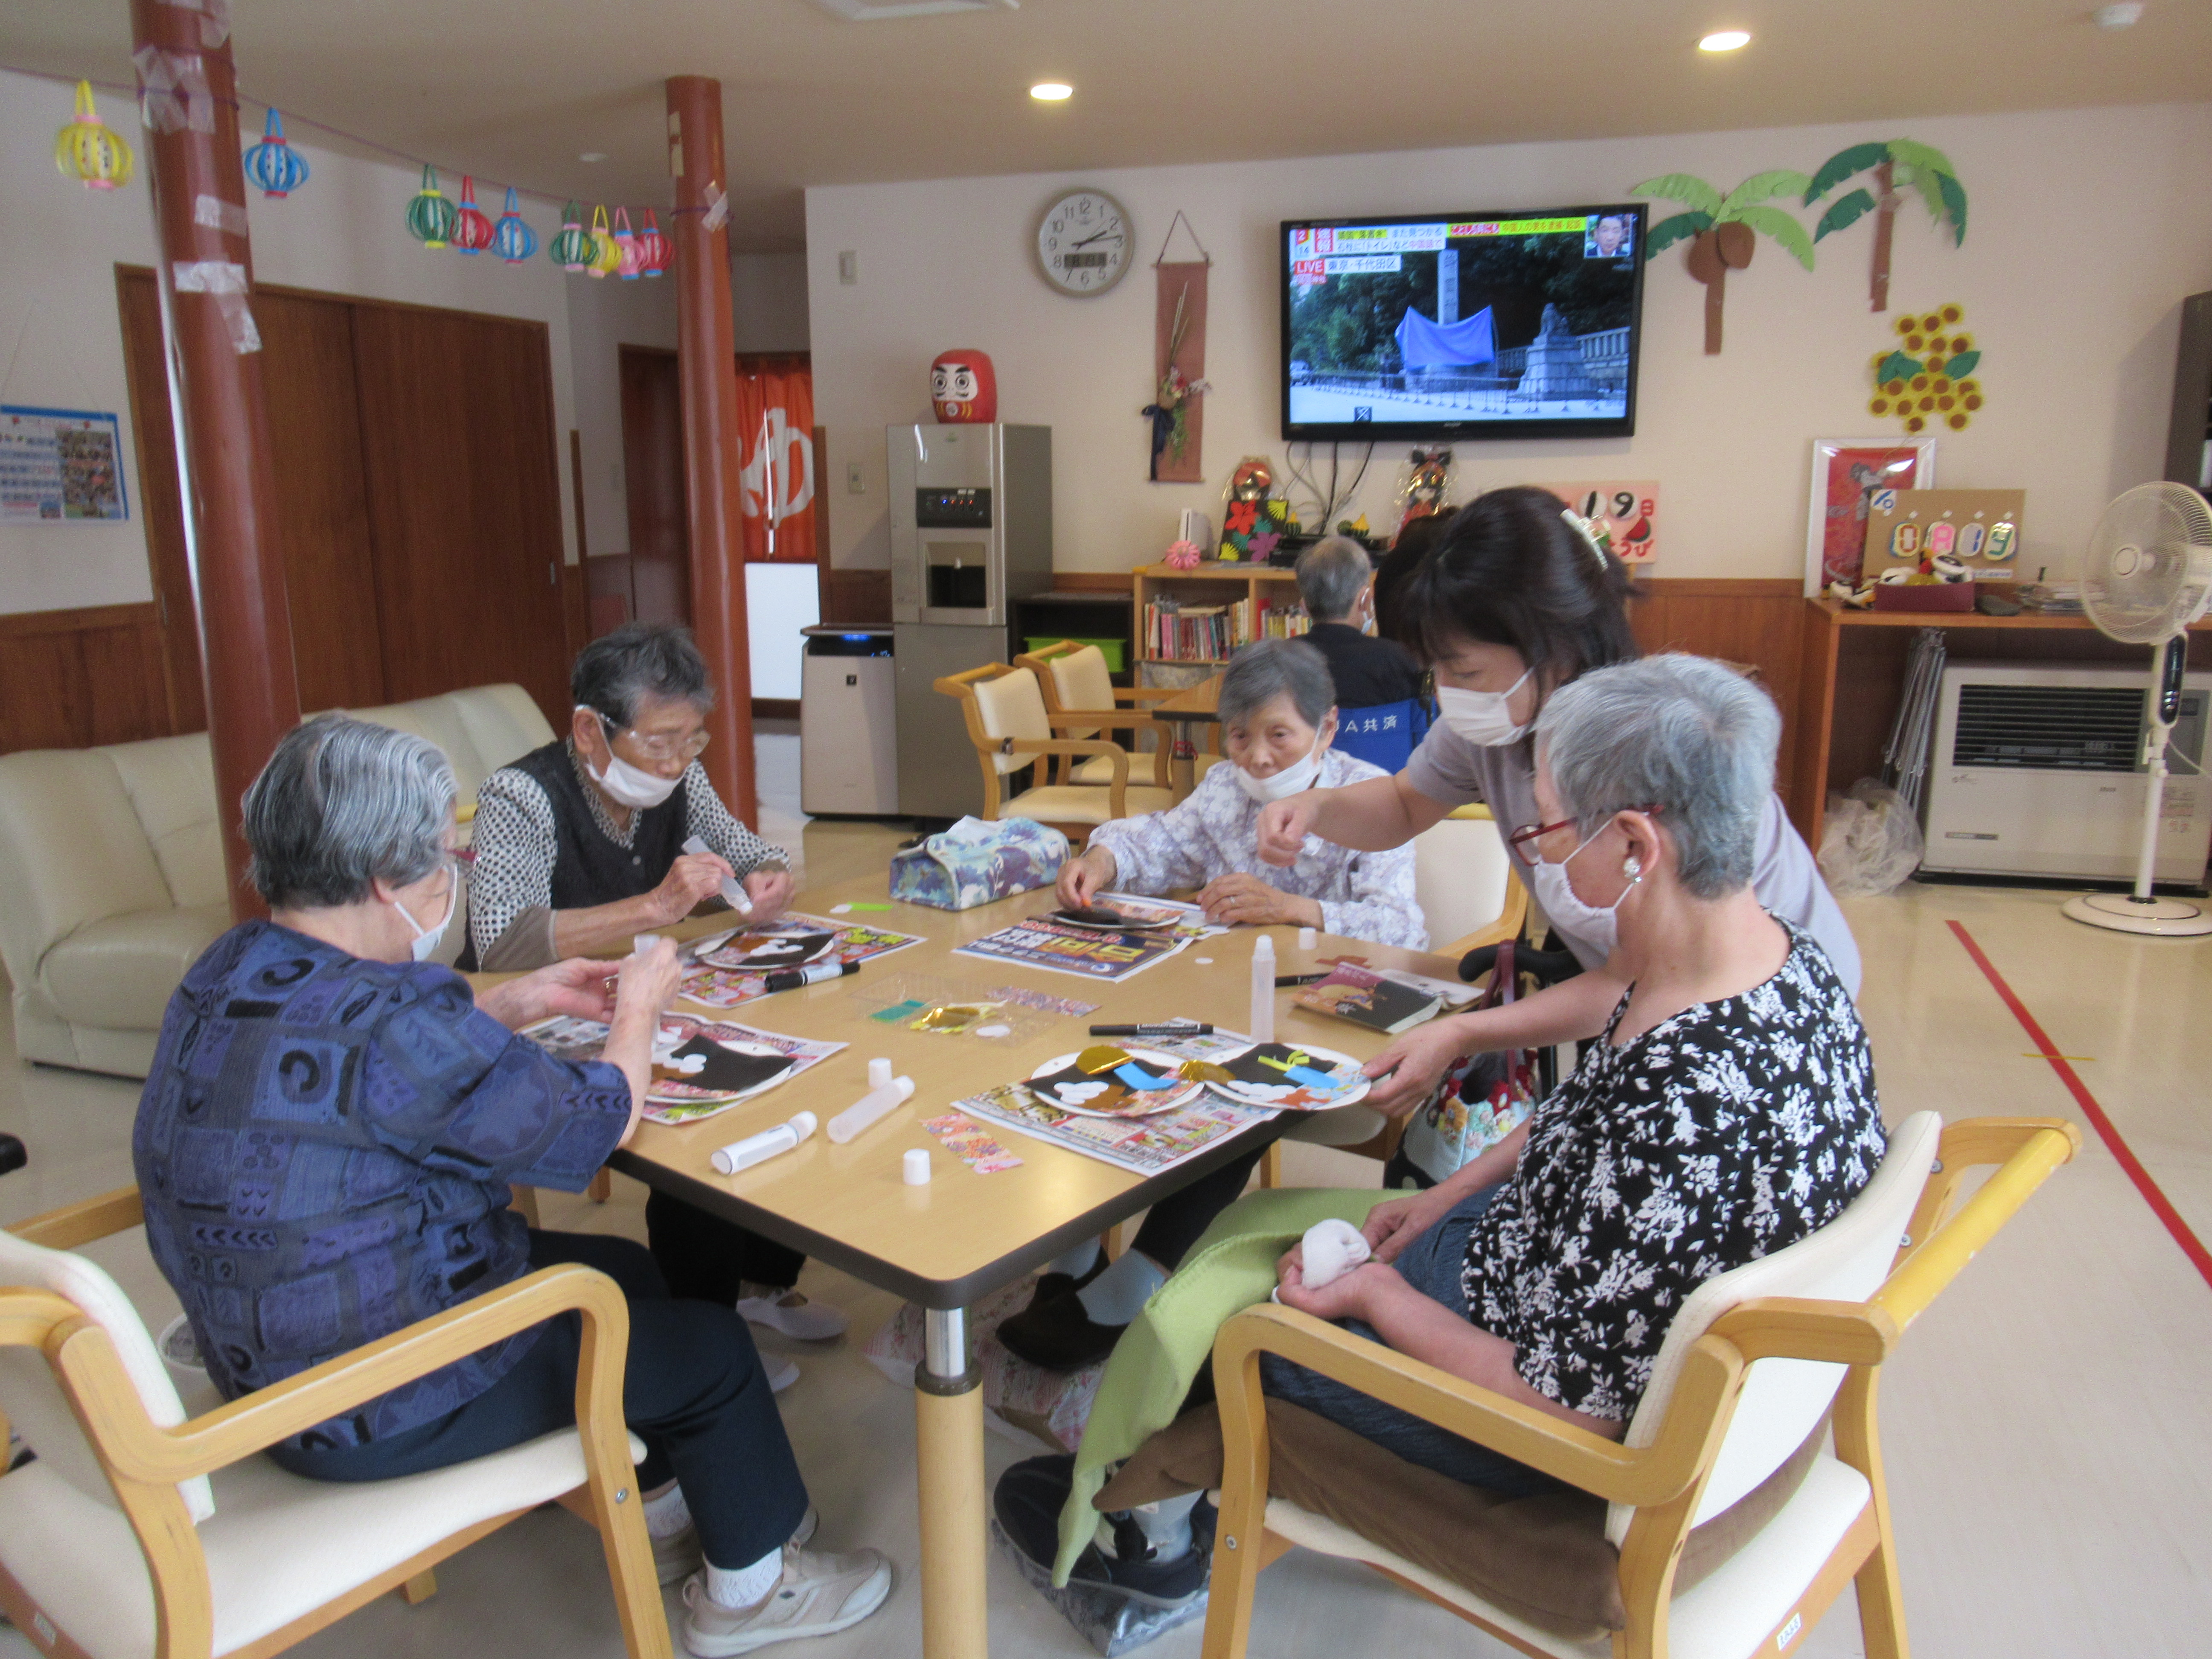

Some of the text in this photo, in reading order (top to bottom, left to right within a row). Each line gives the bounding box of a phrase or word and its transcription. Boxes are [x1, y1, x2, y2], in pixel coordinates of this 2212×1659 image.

[1064, 206, 1074, 219] 11
[1078, 198, 1091, 215] 12
[1052, 219, 1064, 234] 10
[1109, 215, 1120, 230] 2
[1114, 236, 1123, 248] 3
[1298, 230, 1306, 241] 2
[1048, 237, 1057, 251] 9
[1053, 255, 1062, 268] 8
[1109, 253, 1118, 265] 4
[1328, 257, 1397, 272] 東京・千代田区
[1297, 260, 1324, 274] LIVE
[1080, 271, 1090, 286] 6
